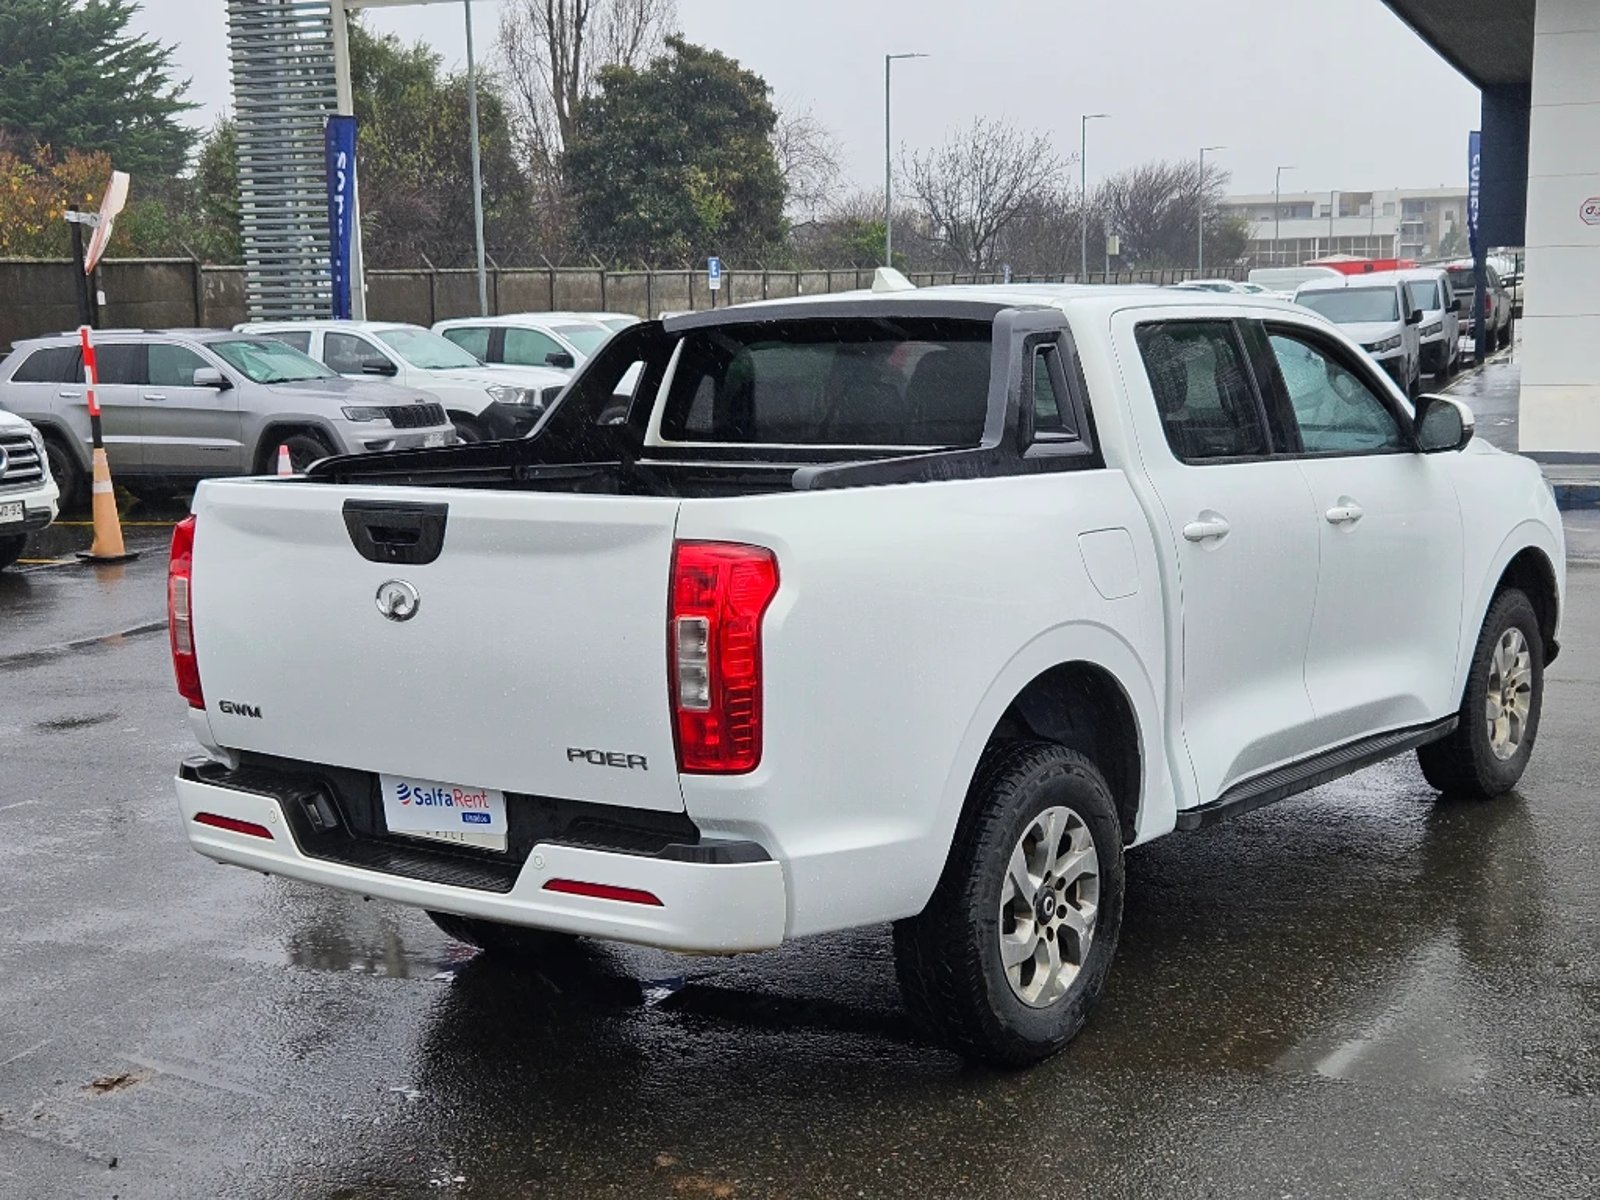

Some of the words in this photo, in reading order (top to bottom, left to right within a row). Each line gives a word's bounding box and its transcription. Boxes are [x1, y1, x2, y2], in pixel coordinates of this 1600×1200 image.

[218, 700, 263, 719] GWM
[567, 747, 648, 771] POER
[413, 787, 489, 808] SalfaRent
